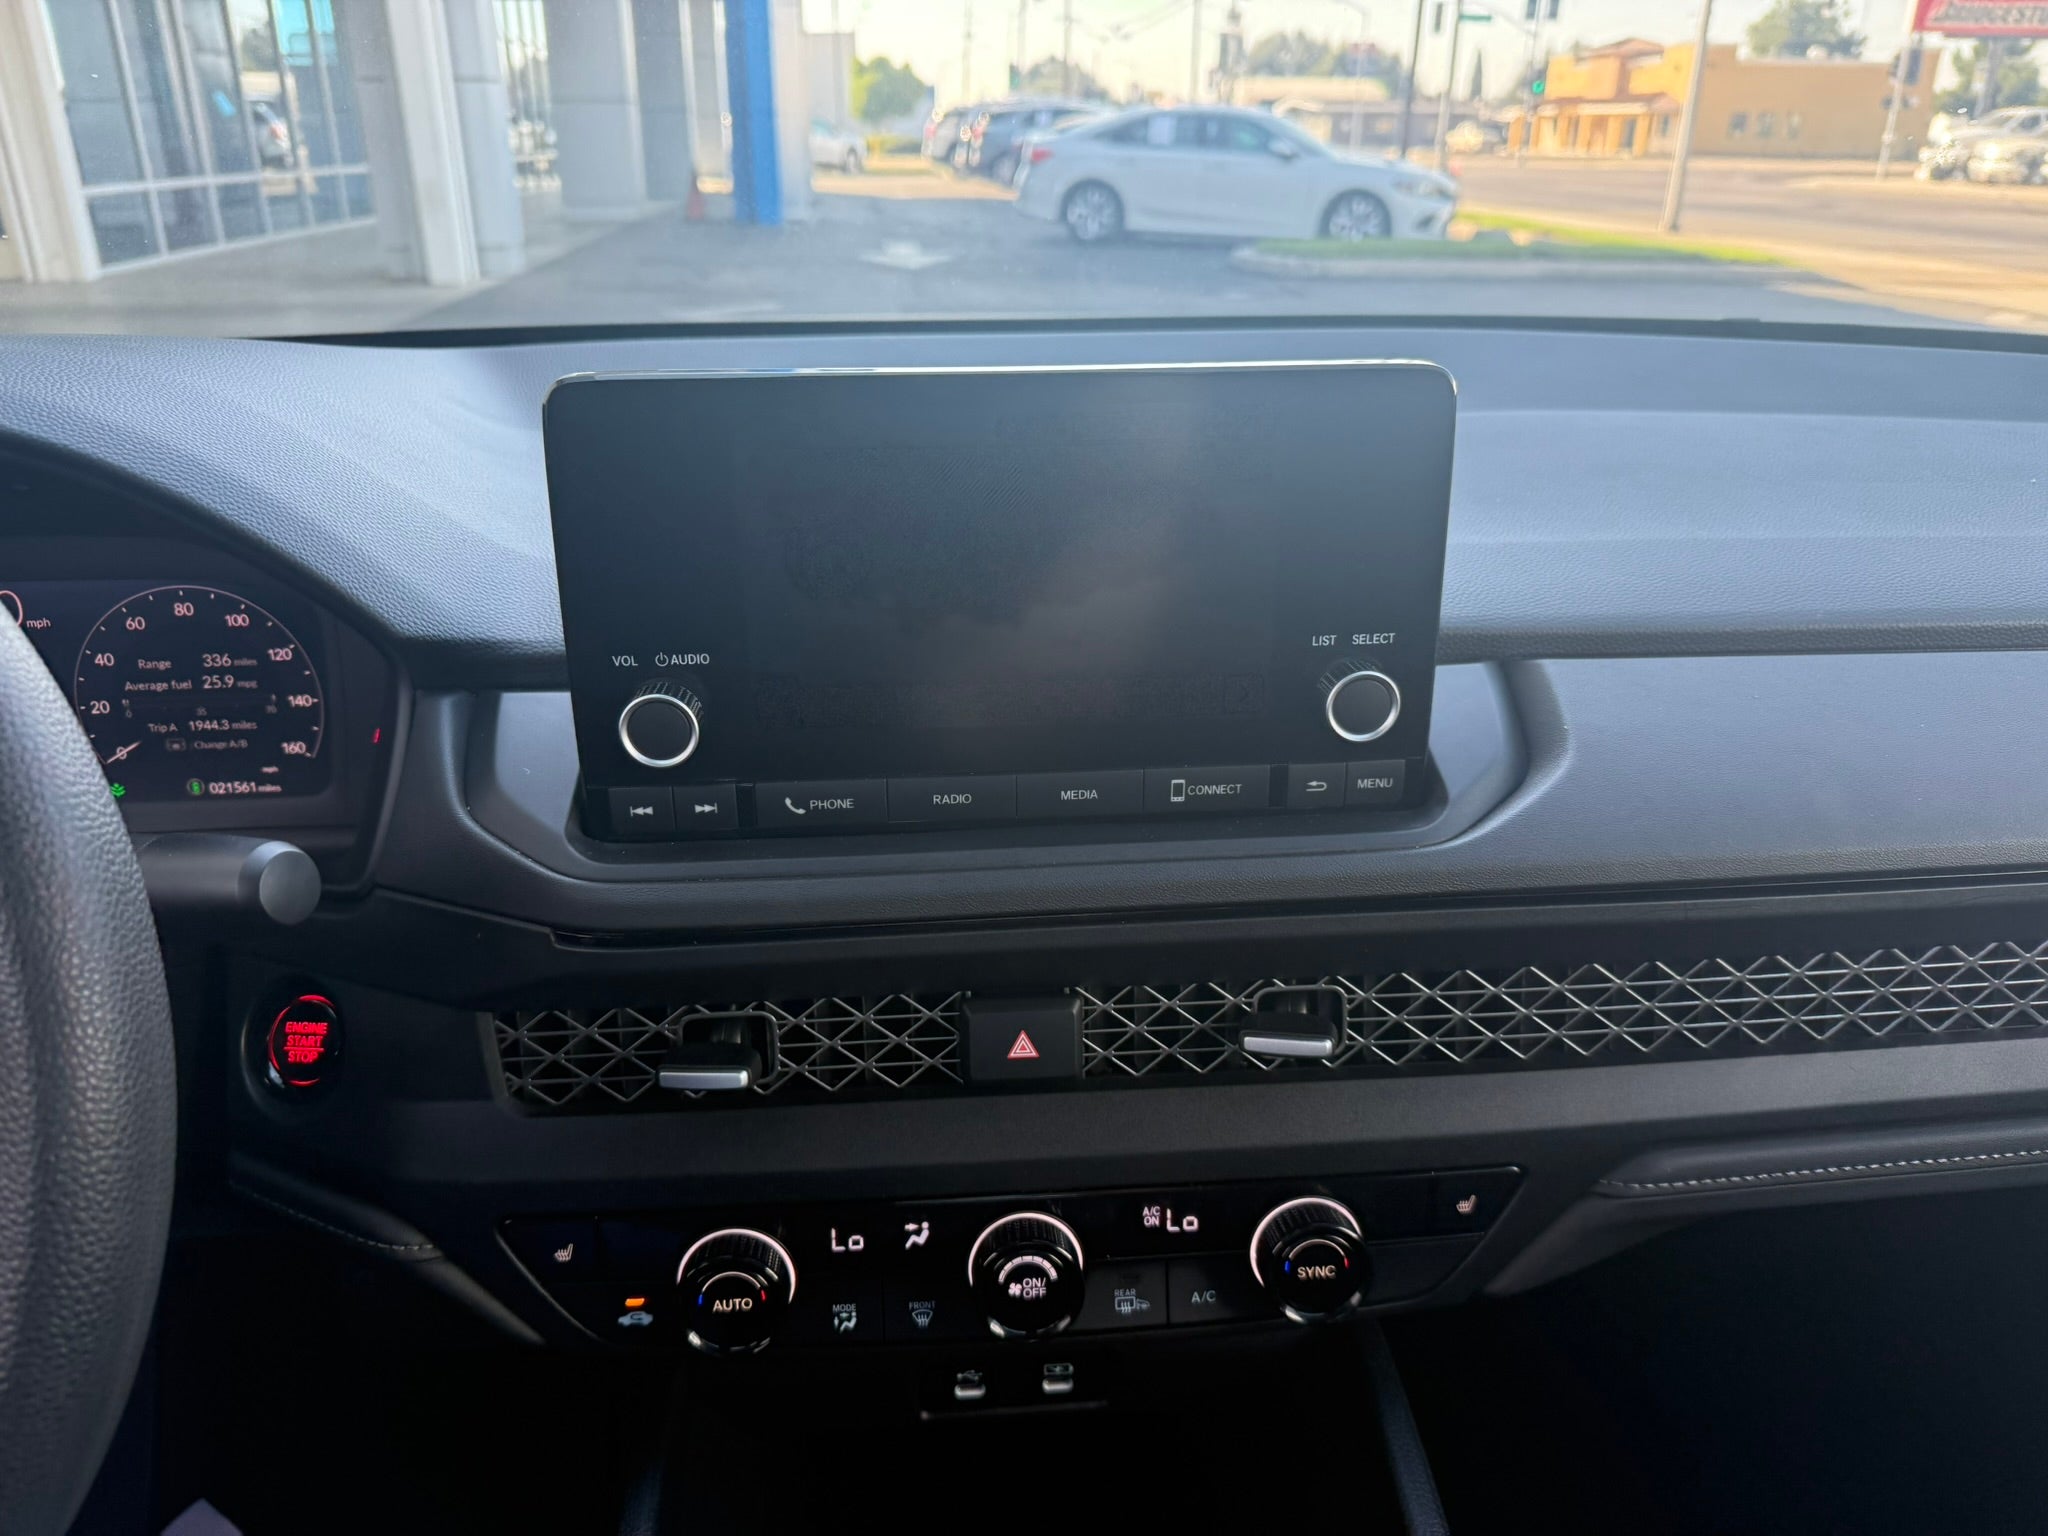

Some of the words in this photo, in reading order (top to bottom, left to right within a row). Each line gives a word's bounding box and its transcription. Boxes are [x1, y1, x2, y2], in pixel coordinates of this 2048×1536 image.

[173, 601, 195, 617] 80
[26, 617, 51, 630] mph
[125, 616, 146, 631] 60
[224, 613, 250, 627] 100
[1311, 634, 1337, 647] LIST
[1352, 632, 1396, 645] SELECT
[94, 652, 115, 667] 40
[267, 647, 293, 661] 120
[670, 653, 710, 666] AUDIO
[137, 658, 172, 671] Range
[202, 652, 232, 668] 336
[611, 655, 639, 667] VOL
[124, 680, 169, 693] Average
[170, 679, 193, 690] fuel
[201, 674, 235, 690] 25.9
[89, 700, 111, 715] 20
[288, 694, 312, 708] 140
[147, 722, 168, 734] Trip
[168, 722, 179, 732] A
[188, 719, 230, 732] 1944.3
[231, 720, 258, 730] miles
[281, 741, 306, 755] 160
[208, 780, 257, 795] 021561
[1187, 783, 1243, 796] CONNECT
[1356, 777, 1394, 789] MENU
[932, 793, 972, 805] RADIO
[1060, 789, 1099, 801] MEDIA
[809, 798, 855, 810] PHONE
[285, 1021, 328, 1035] ENGINE
[286, 1034, 323, 1047] START
[288, 1051, 319, 1064] STOP
[1142, 1206, 1161, 1217] A/C
[1143, 1216, 1160, 1227] ON
[1166, 1208, 1199, 1233] Lo
[830, 1227, 865, 1253] Lo
[1297, 1264, 1336, 1280] SYNC
[1022, 1287, 1047, 1299] OFF
[1113, 1288, 1136, 1297] REAR
[1190, 1289, 1216, 1305] A/C
[712, 1297, 753, 1313] AUTO
[832, 1303, 857, 1312] MODE
[909, 1300, 936, 1310] FRONT
